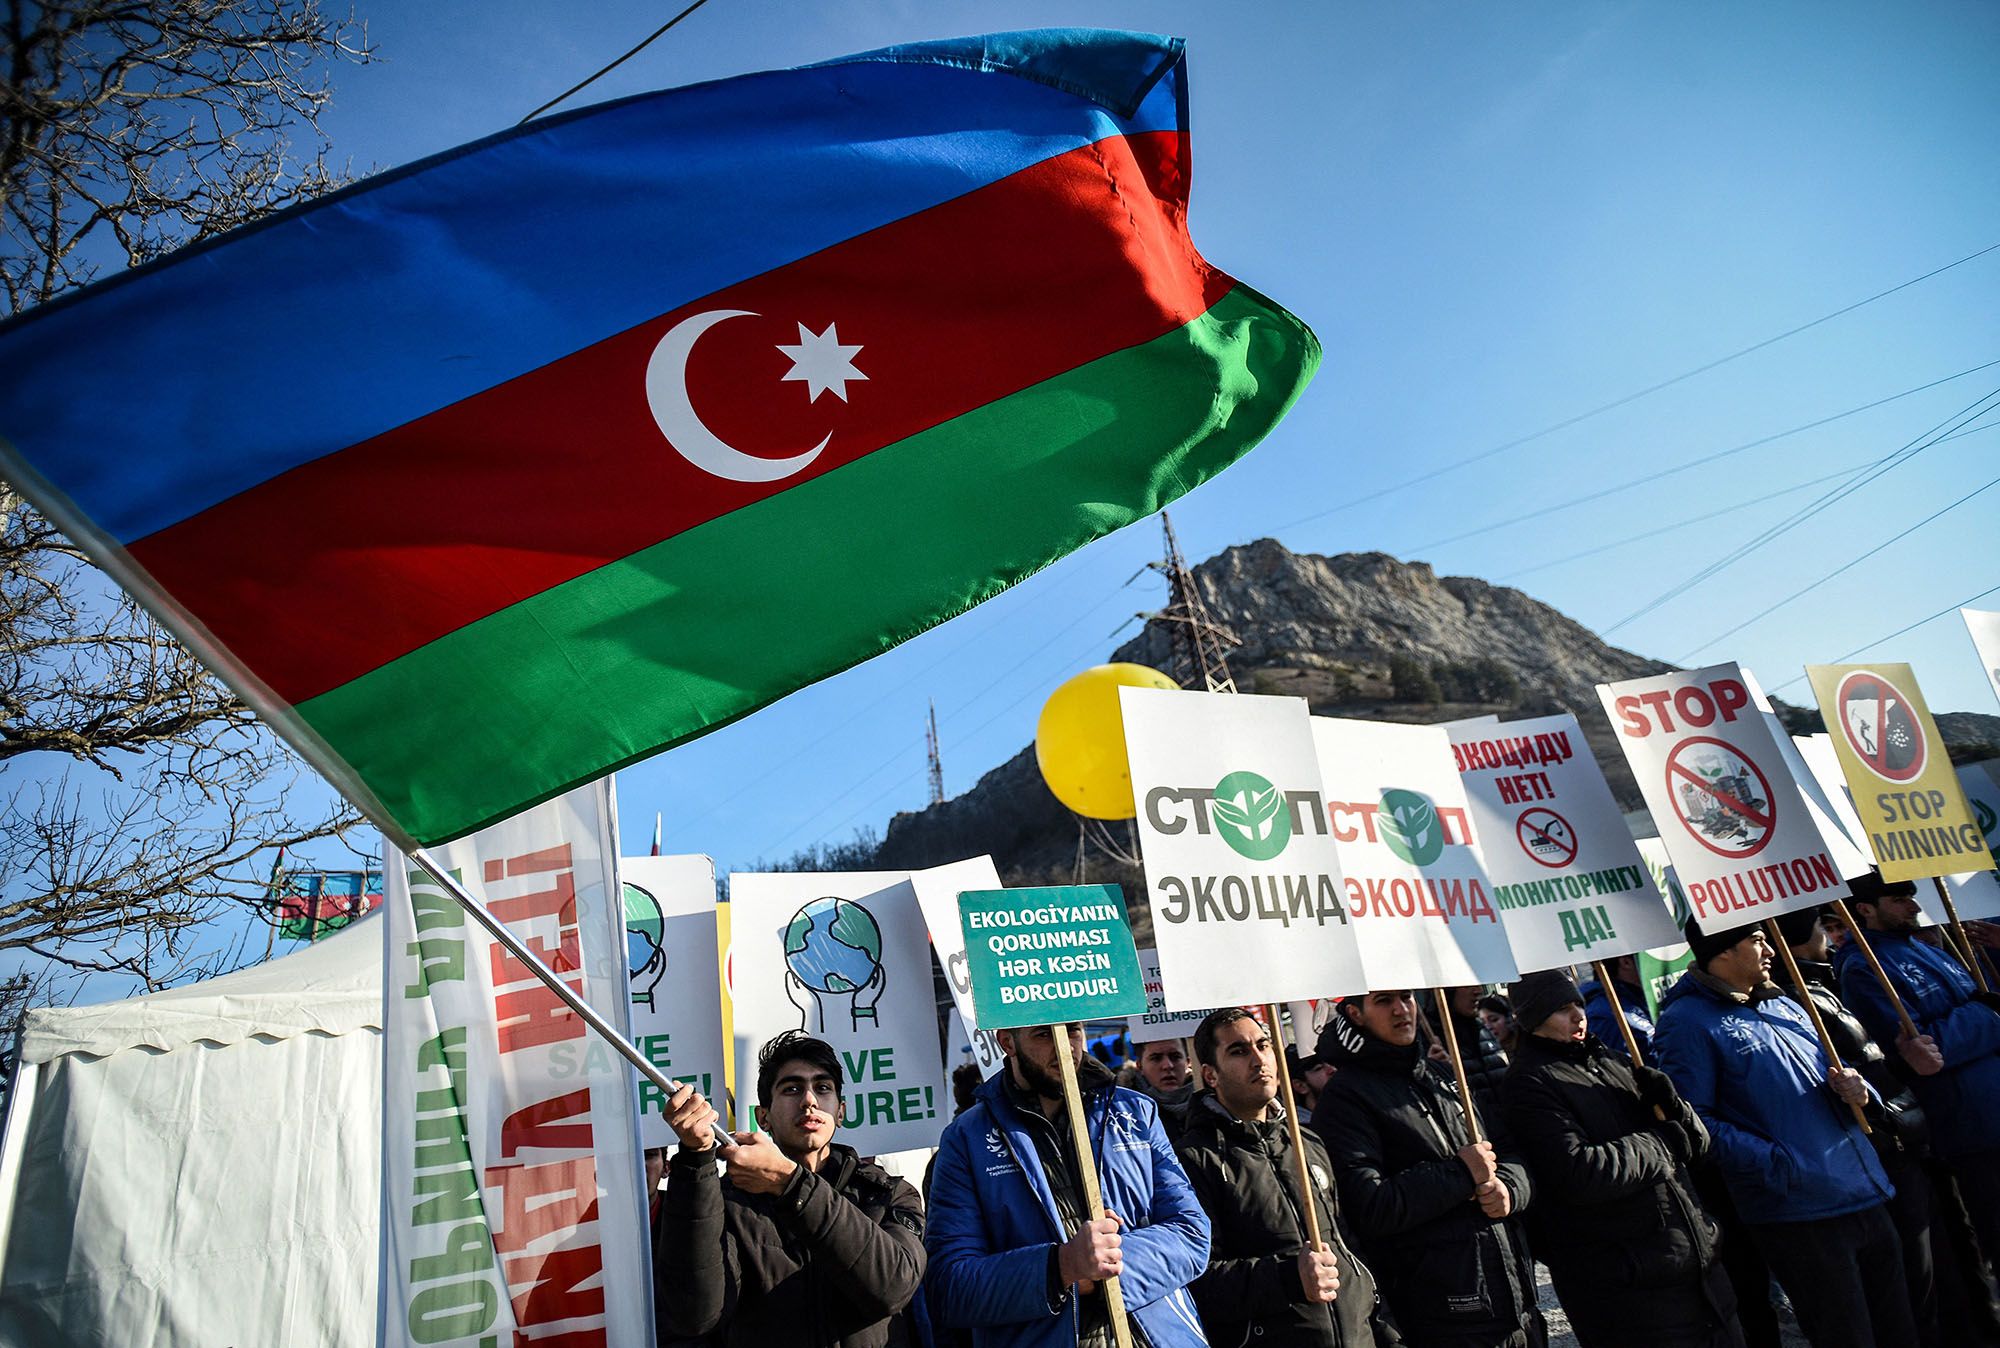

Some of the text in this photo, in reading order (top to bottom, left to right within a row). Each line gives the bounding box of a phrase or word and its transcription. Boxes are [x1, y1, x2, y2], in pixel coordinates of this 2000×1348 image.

[1615, 679, 1748, 738] STOP
[1495, 772, 1555, 805] НЕТ!
[1877, 790, 1945, 823] STOP
[1145, 771, 1329, 861] СТОП
[1872, 823, 1984, 862] MINING
[1158, 874, 1347, 928] ЭКОЦИД
[1344, 877, 1497, 924] ЭКОЦИД
[1494, 864, 1643, 910] МОНИТОРИНГУ
[1688, 853, 1839, 918] POLLUTION
[969, 904, 1119, 929] EKOLOGİYANIN
[1558, 905, 1616, 952] ДА!
[988, 929, 1111, 956] QORUNMASI
[999, 950, 1111, 978] HƏR KƏSİN
[1000, 978, 1119, 1004] BORCUDUR!
